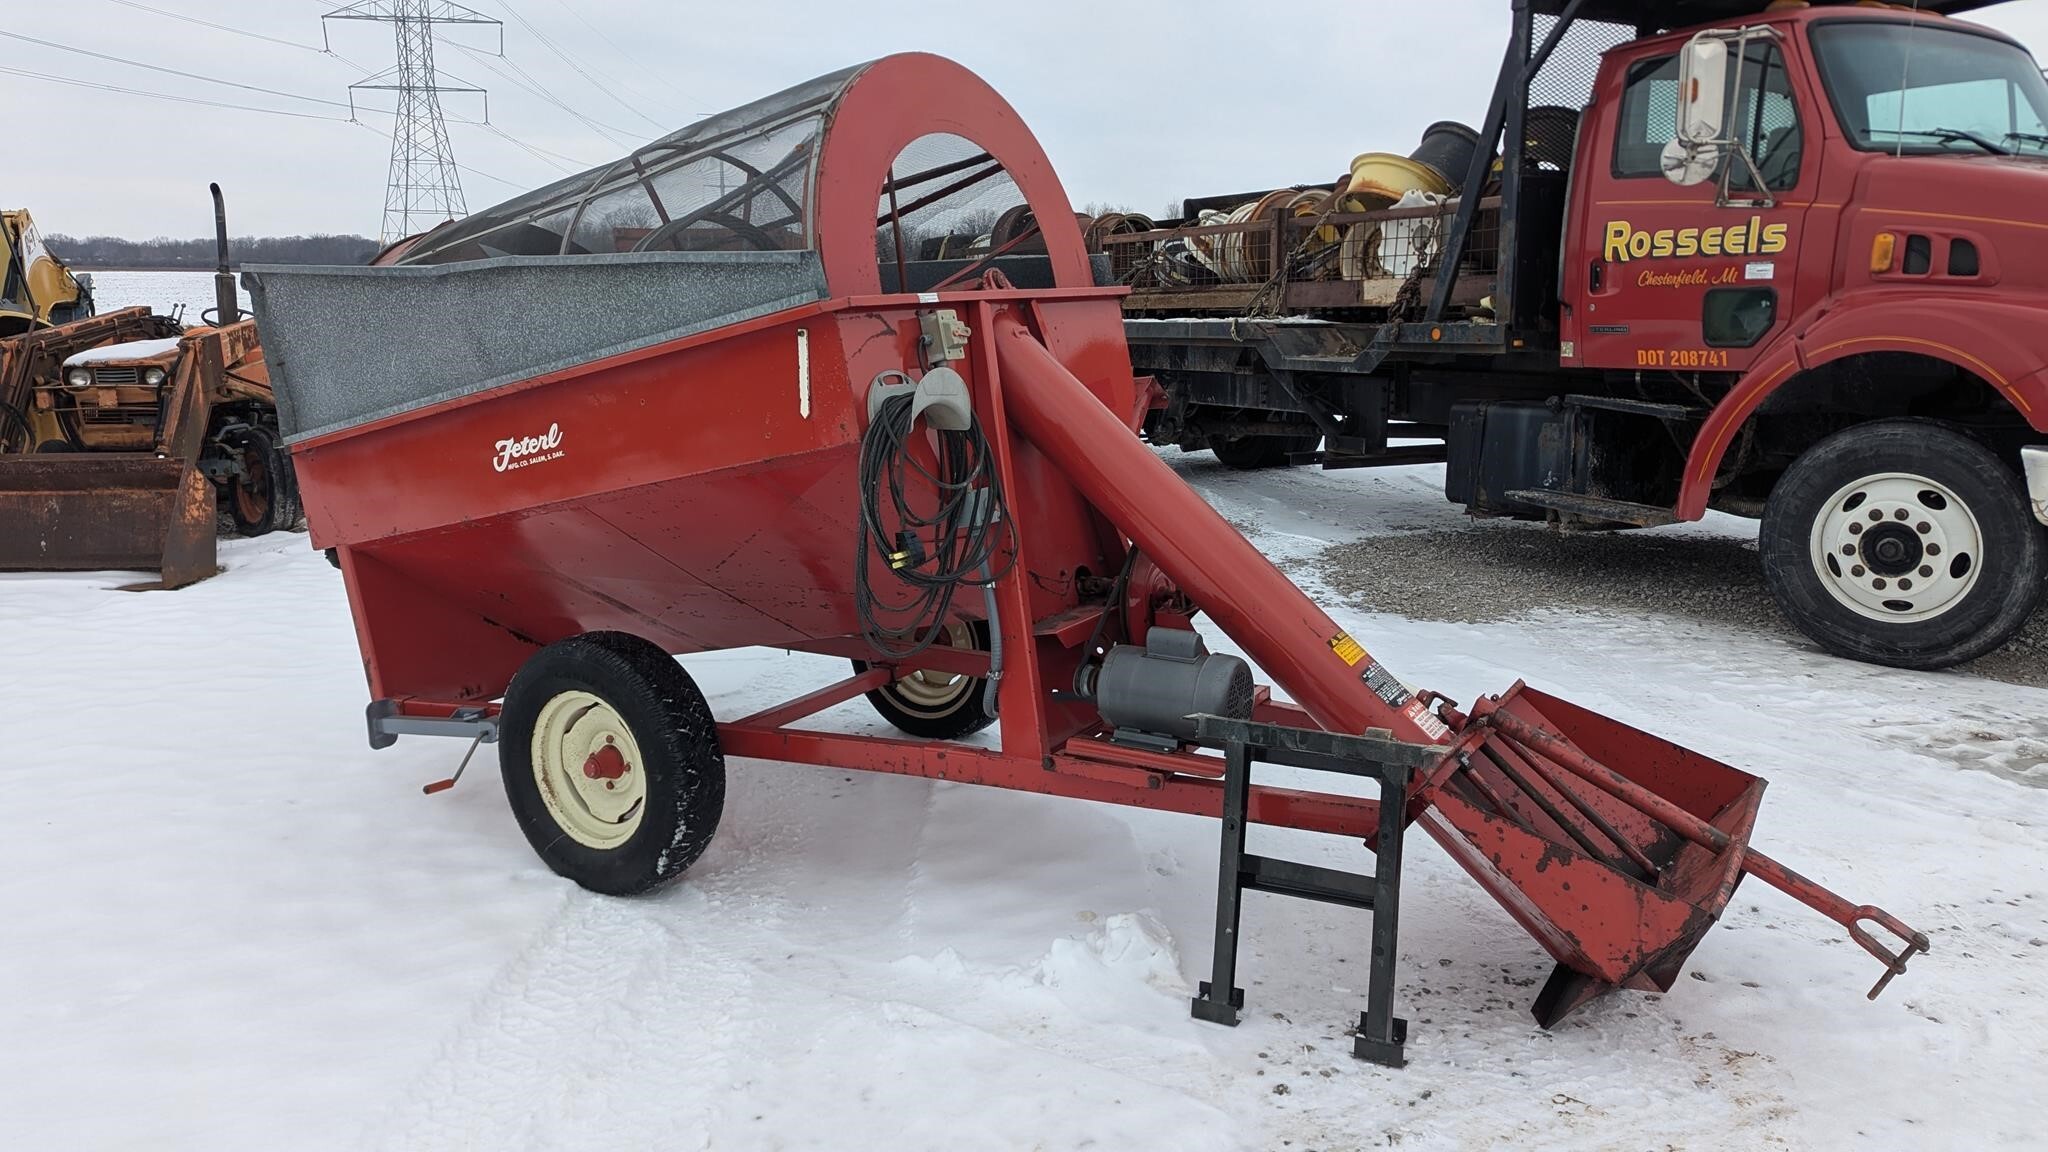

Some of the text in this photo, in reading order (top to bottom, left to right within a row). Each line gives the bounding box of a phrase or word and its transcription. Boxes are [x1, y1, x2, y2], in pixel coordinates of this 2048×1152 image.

[1603, 215, 1788, 262] Rosseels
[1637, 349, 1728, 367] DOT 208741
[493, 422, 563, 472] Feterl
